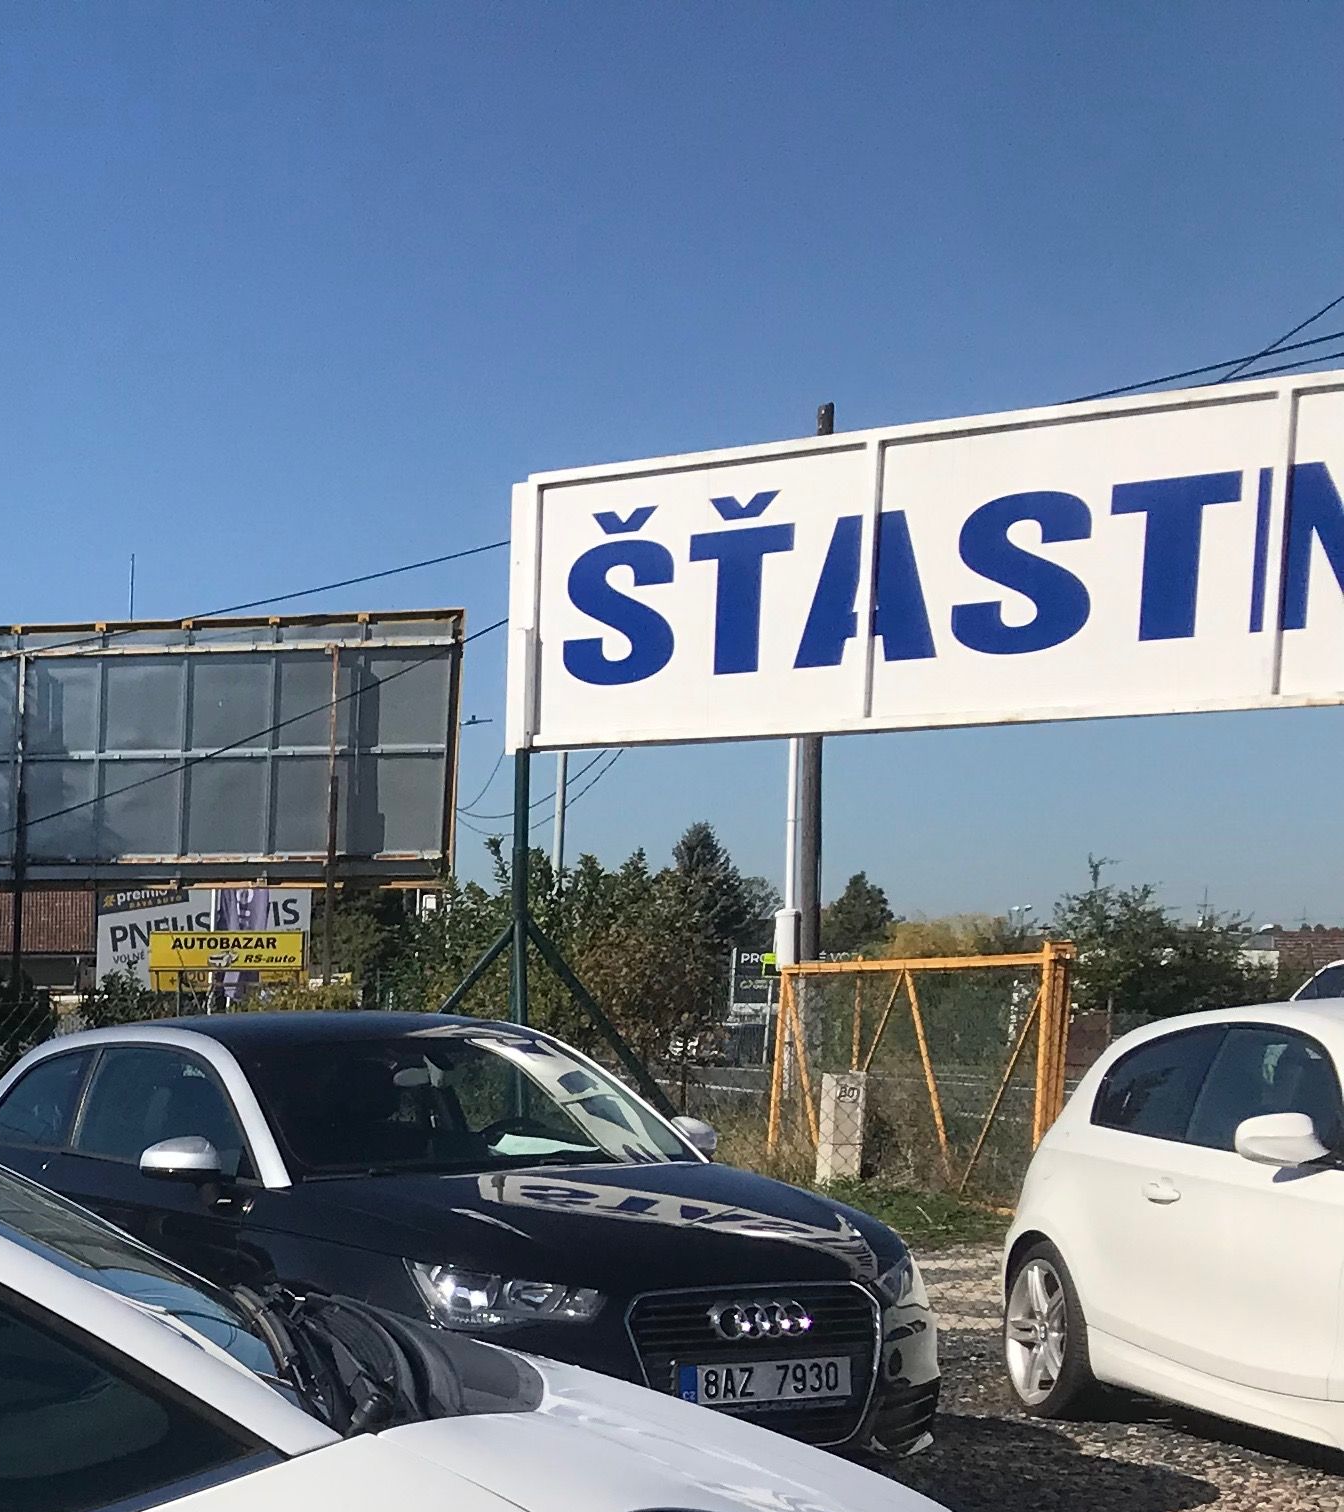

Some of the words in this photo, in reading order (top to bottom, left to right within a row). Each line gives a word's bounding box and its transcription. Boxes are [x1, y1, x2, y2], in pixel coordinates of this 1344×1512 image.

[171, 936, 277, 950] AUTOBAZAR
[243, 954, 297, 965] RS-auto
[703, 1368, 755, 1400] 8AZ
[775, 1361, 839, 1396] 7930
